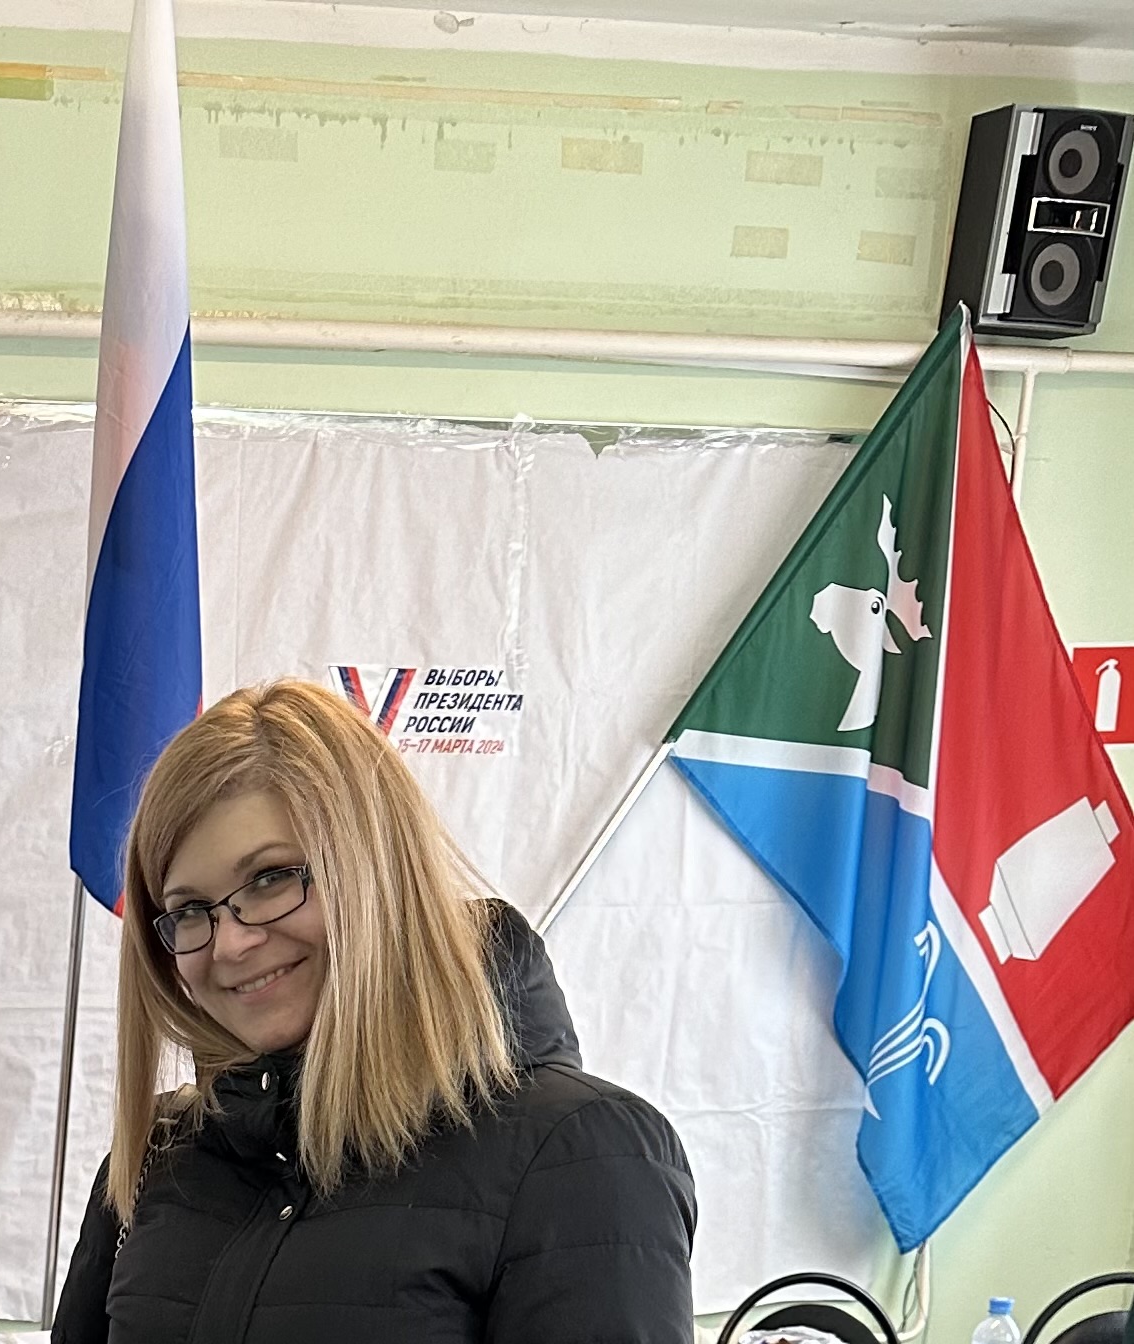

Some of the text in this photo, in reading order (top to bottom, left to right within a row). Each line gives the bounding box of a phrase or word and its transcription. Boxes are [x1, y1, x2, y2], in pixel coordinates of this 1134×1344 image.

[423, 668, 504, 687] ВЫБОРЫ
[413, 692, 524, 712] ПРЕЗИДЕНТА
[403, 716, 476, 733] РОССИИ
[433, 739, 474, 754] МАРТА
[475, 740, 505, 755] 2024
